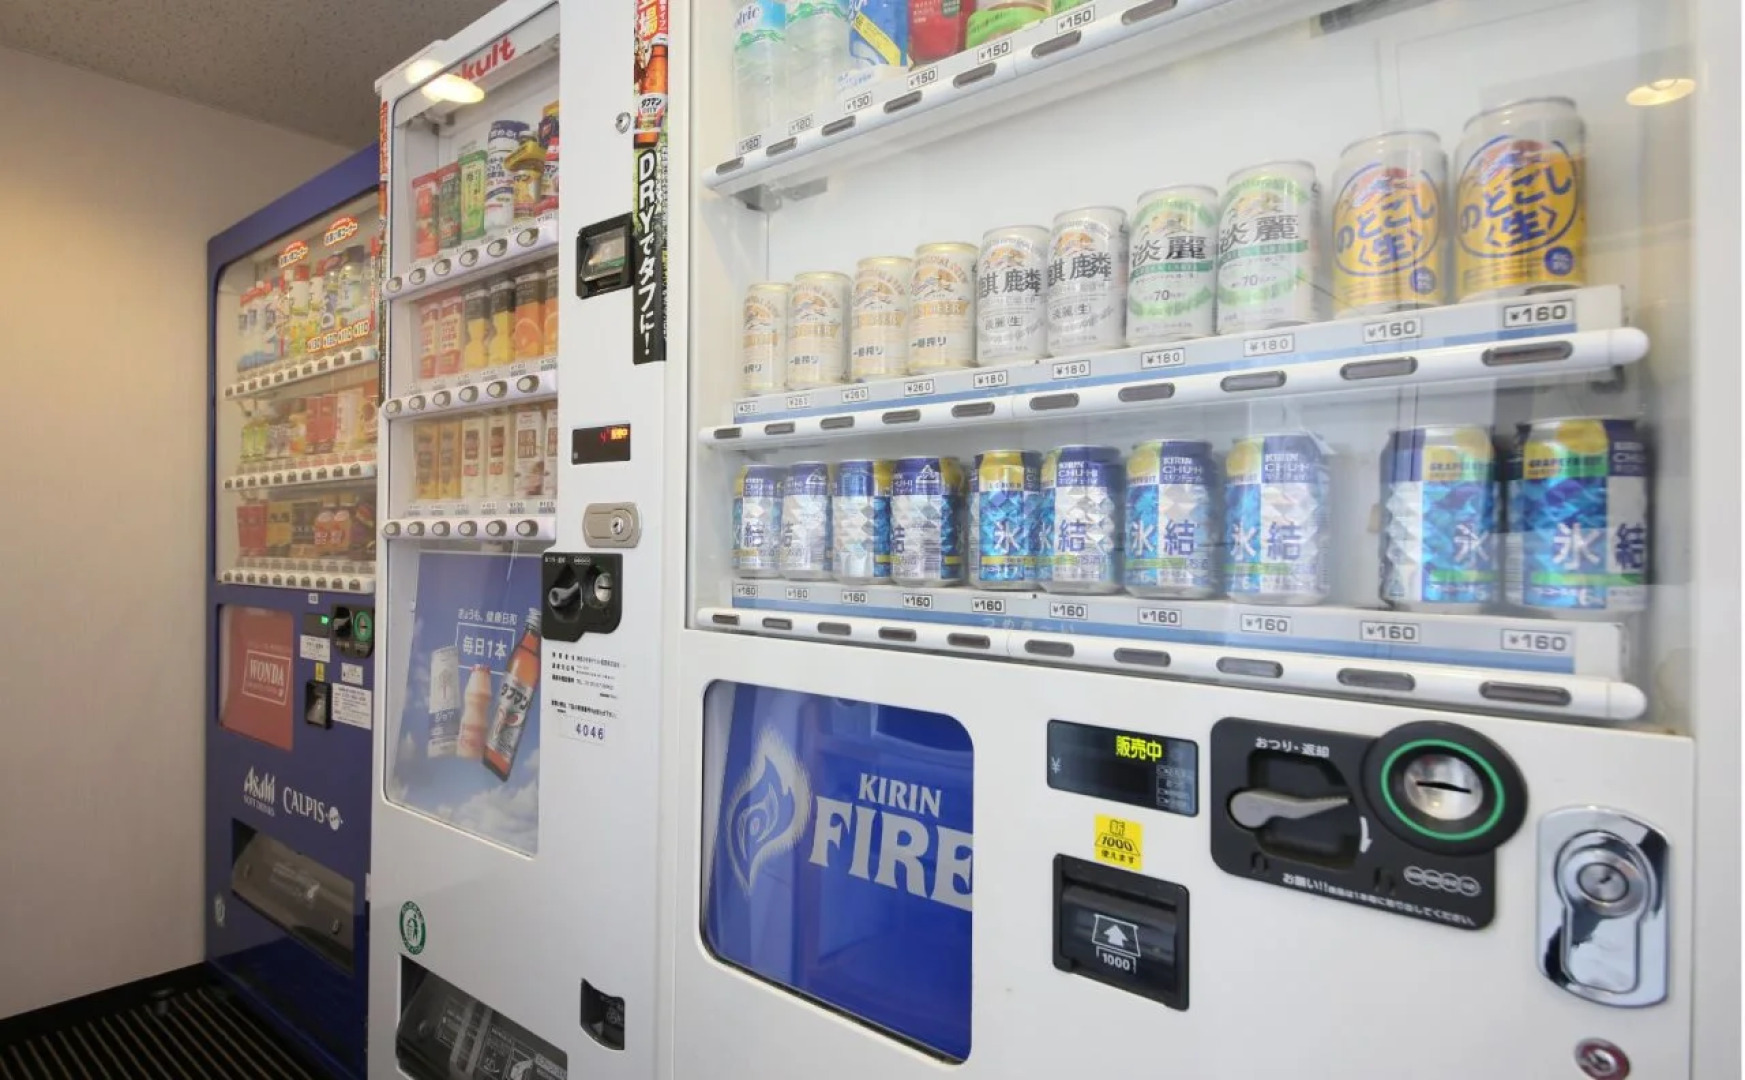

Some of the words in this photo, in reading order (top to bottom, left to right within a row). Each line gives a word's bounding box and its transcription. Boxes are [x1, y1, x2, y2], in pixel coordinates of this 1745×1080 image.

[1060, 10, 1091, 29] ¥150
[980, 41, 1009, 59] ¥150
[910, 69, 936, 86] ¥150
[1460, 166, 1572, 234] のどごし
[1337, 192, 1436, 254] のどごし
[1219, 214, 1300, 253] 淡麗
[638, 150, 657, 356] DRYでタフに!
[1132, 235, 1207, 268] 淡麗
[1511, 305, 1567, 322] ¥160
[1367, 320, 1416, 338] ¥160
[1251, 338, 1289, 350] ¥180
[1147, 351, 1180, 364] ¥180
[1057, 364, 1086, 375] ¥180
[907, 383, 931, 393] ¥260
[978, 374, 1004, 384] ¥180
[994, 520, 1024, 553] 氷
[1130, 518, 1196, 556] 氷結
[1231, 520, 1301, 562] 氷結
[1453, 523, 1491, 564] 氷
[788, 588, 808, 598] ¥160
[843, 592, 866, 602] ¥160
[905, 596, 930, 607] ¥160
[975, 600, 1003, 611] ¥160
[1054, 604, 1084, 617] ¥160
[1142, 610, 1178, 624] ¥160
[1246, 617, 1287, 631] ¥160
[1366, 624, 1415, 640] ¥160
[463, 635, 507, 661] 毎日1本
[1509, 634, 1566, 650] ¥160
[576, 723, 604, 740] 4046
[1115, 735, 1163, 761] 販売中
[244, 766, 275, 806] Asahi
[858, 772, 942, 819] KIRIN
[283, 786, 325, 824] CALPIS
[1101, 835, 1133, 852] 1000
[809, 795, 974, 912] FIRE
[1101, 952, 1131, 971] 1000
